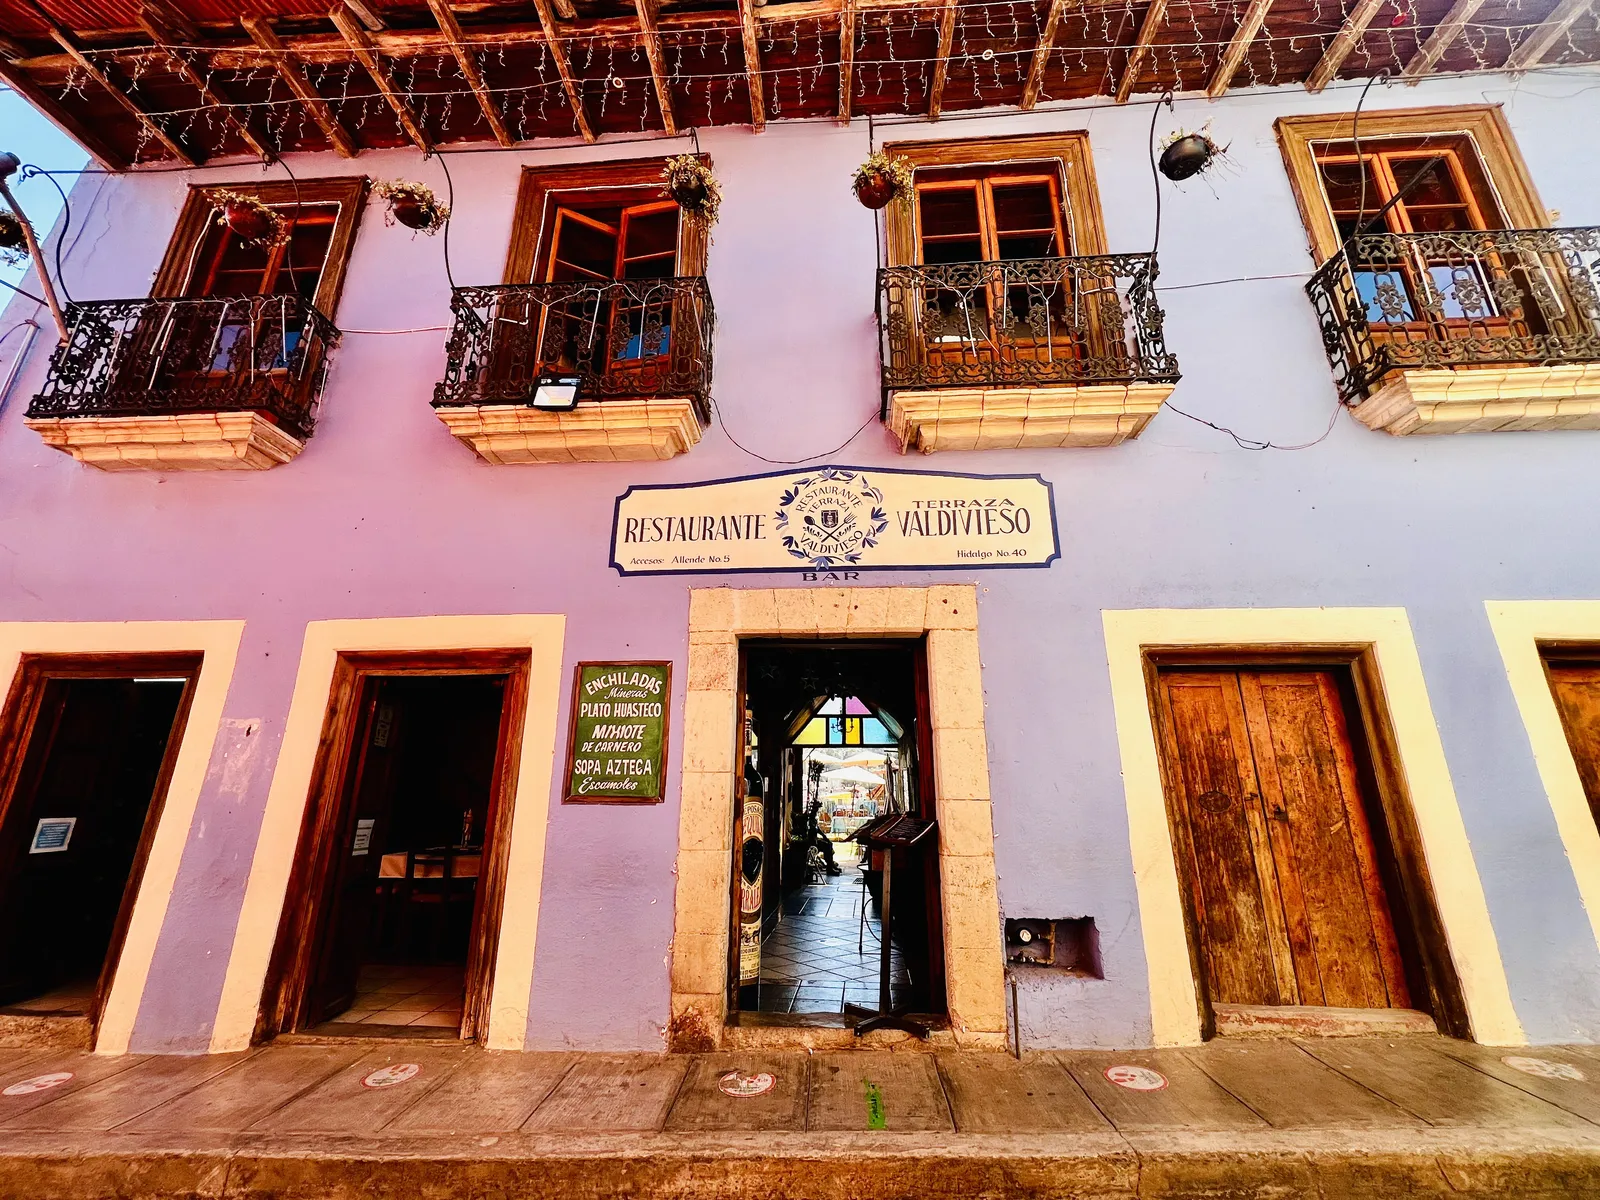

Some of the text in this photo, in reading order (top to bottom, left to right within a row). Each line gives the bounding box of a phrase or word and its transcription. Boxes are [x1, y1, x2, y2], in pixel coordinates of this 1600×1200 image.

[796, 486, 863, 512] RESTAURANTE
[808, 497, 850, 514] TERRAZA
[912, 498, 1015, 509] TERRAZA
[624, 514, 766, 543] RESTAURANTE
[896, 507, 1031, 537] VALDIVIESO
[800, 530, 863, 554] VALDIVIESO
[630, 557, 665, 565] Accesos:
[671, 555, 706, 564] Allende
[957, 550, 992, 560] Hidalgo
[802, 571, 860, 581] BAR
[585, 671, 662, 695] ENCHILADAS
[580, 702, 662, 718] PLATO HUASTECO
[581, 741, 642, 752] DE CARNERO
[574, 758, 652, 775] SOPA AZTECA
[578, 776, 638, 794] Escamoles
